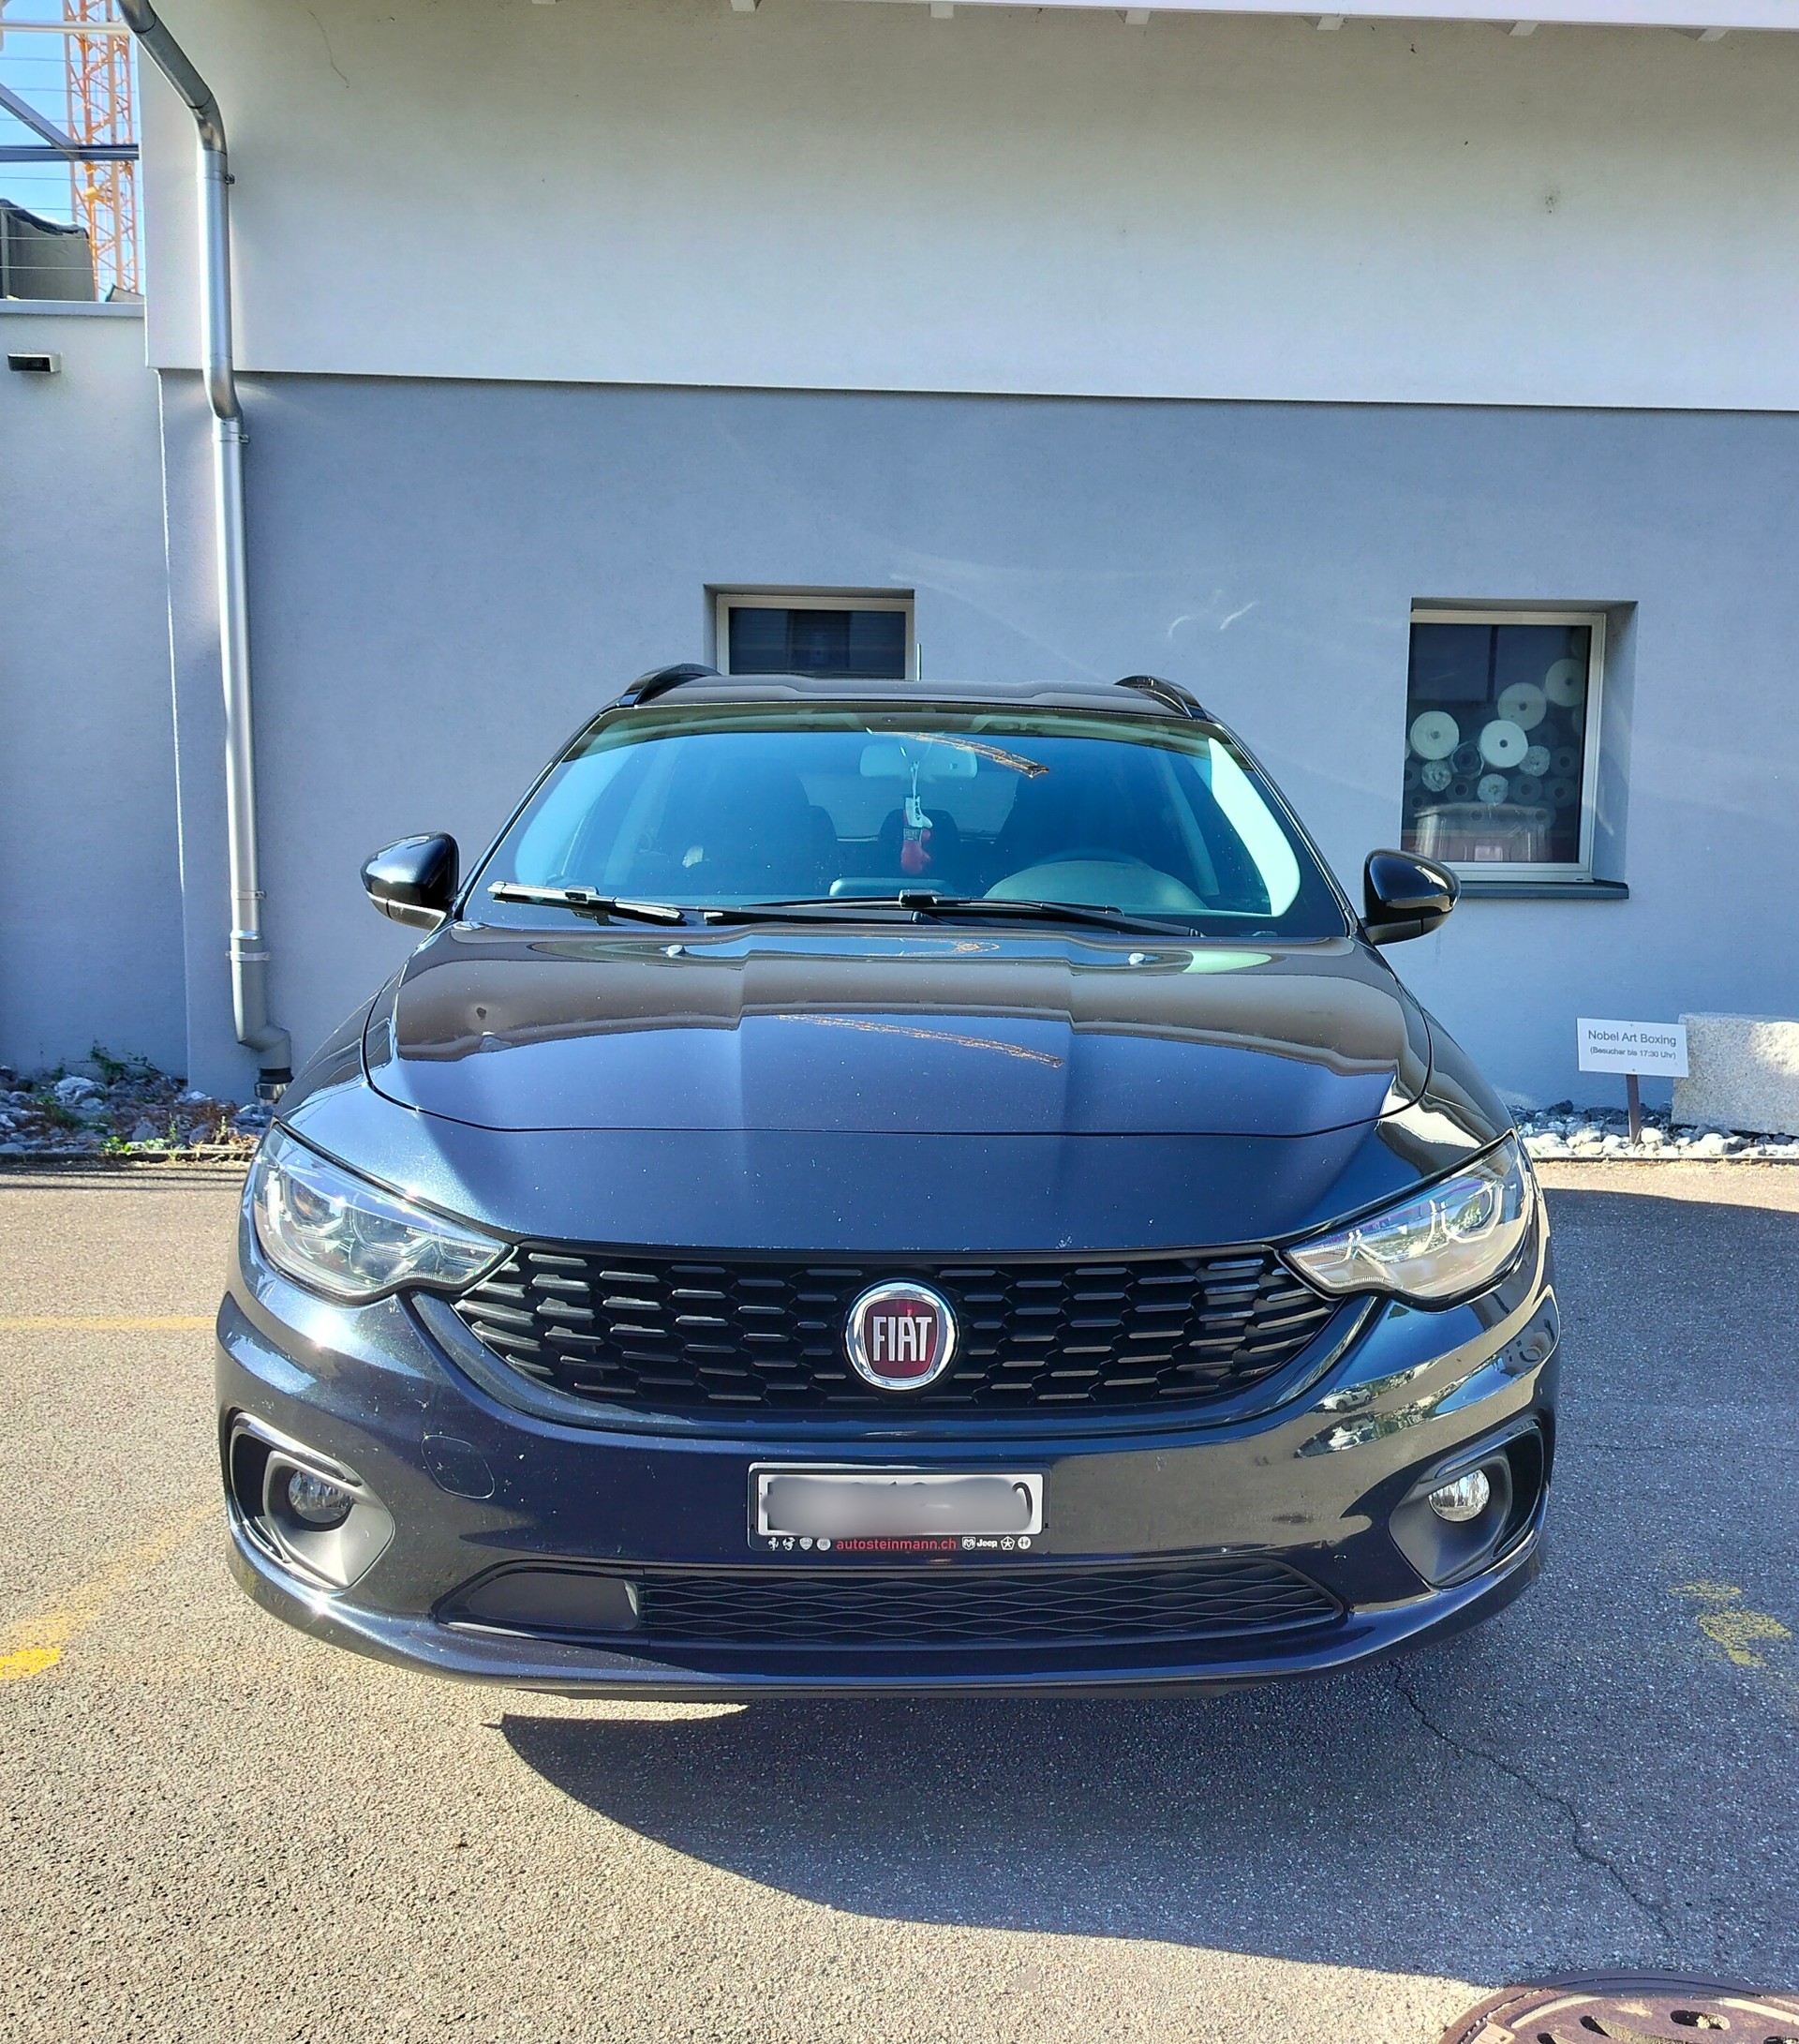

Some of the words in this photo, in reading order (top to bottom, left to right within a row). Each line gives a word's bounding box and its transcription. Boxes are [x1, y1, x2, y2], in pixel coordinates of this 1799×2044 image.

[1588, 1030, 1619, 1041] Nobel
[1621, 1032, 1638, 1042] Art
[1640, 1034, 1676, 1048] Boxing
[1590, 1046, 1626, 1055] (Besucher
[1628, 1048, 1638, 1056] bis
[1640, 1050, 1659, 1058] 17:30
[1660, 1051, 1676, 1060] Uhr)
[872, 1316, 932, 1362] FIAT
[836, 1537, 957, 1551] autosteinmann.ch
[976, 1538, 998, 1548] Jeep
